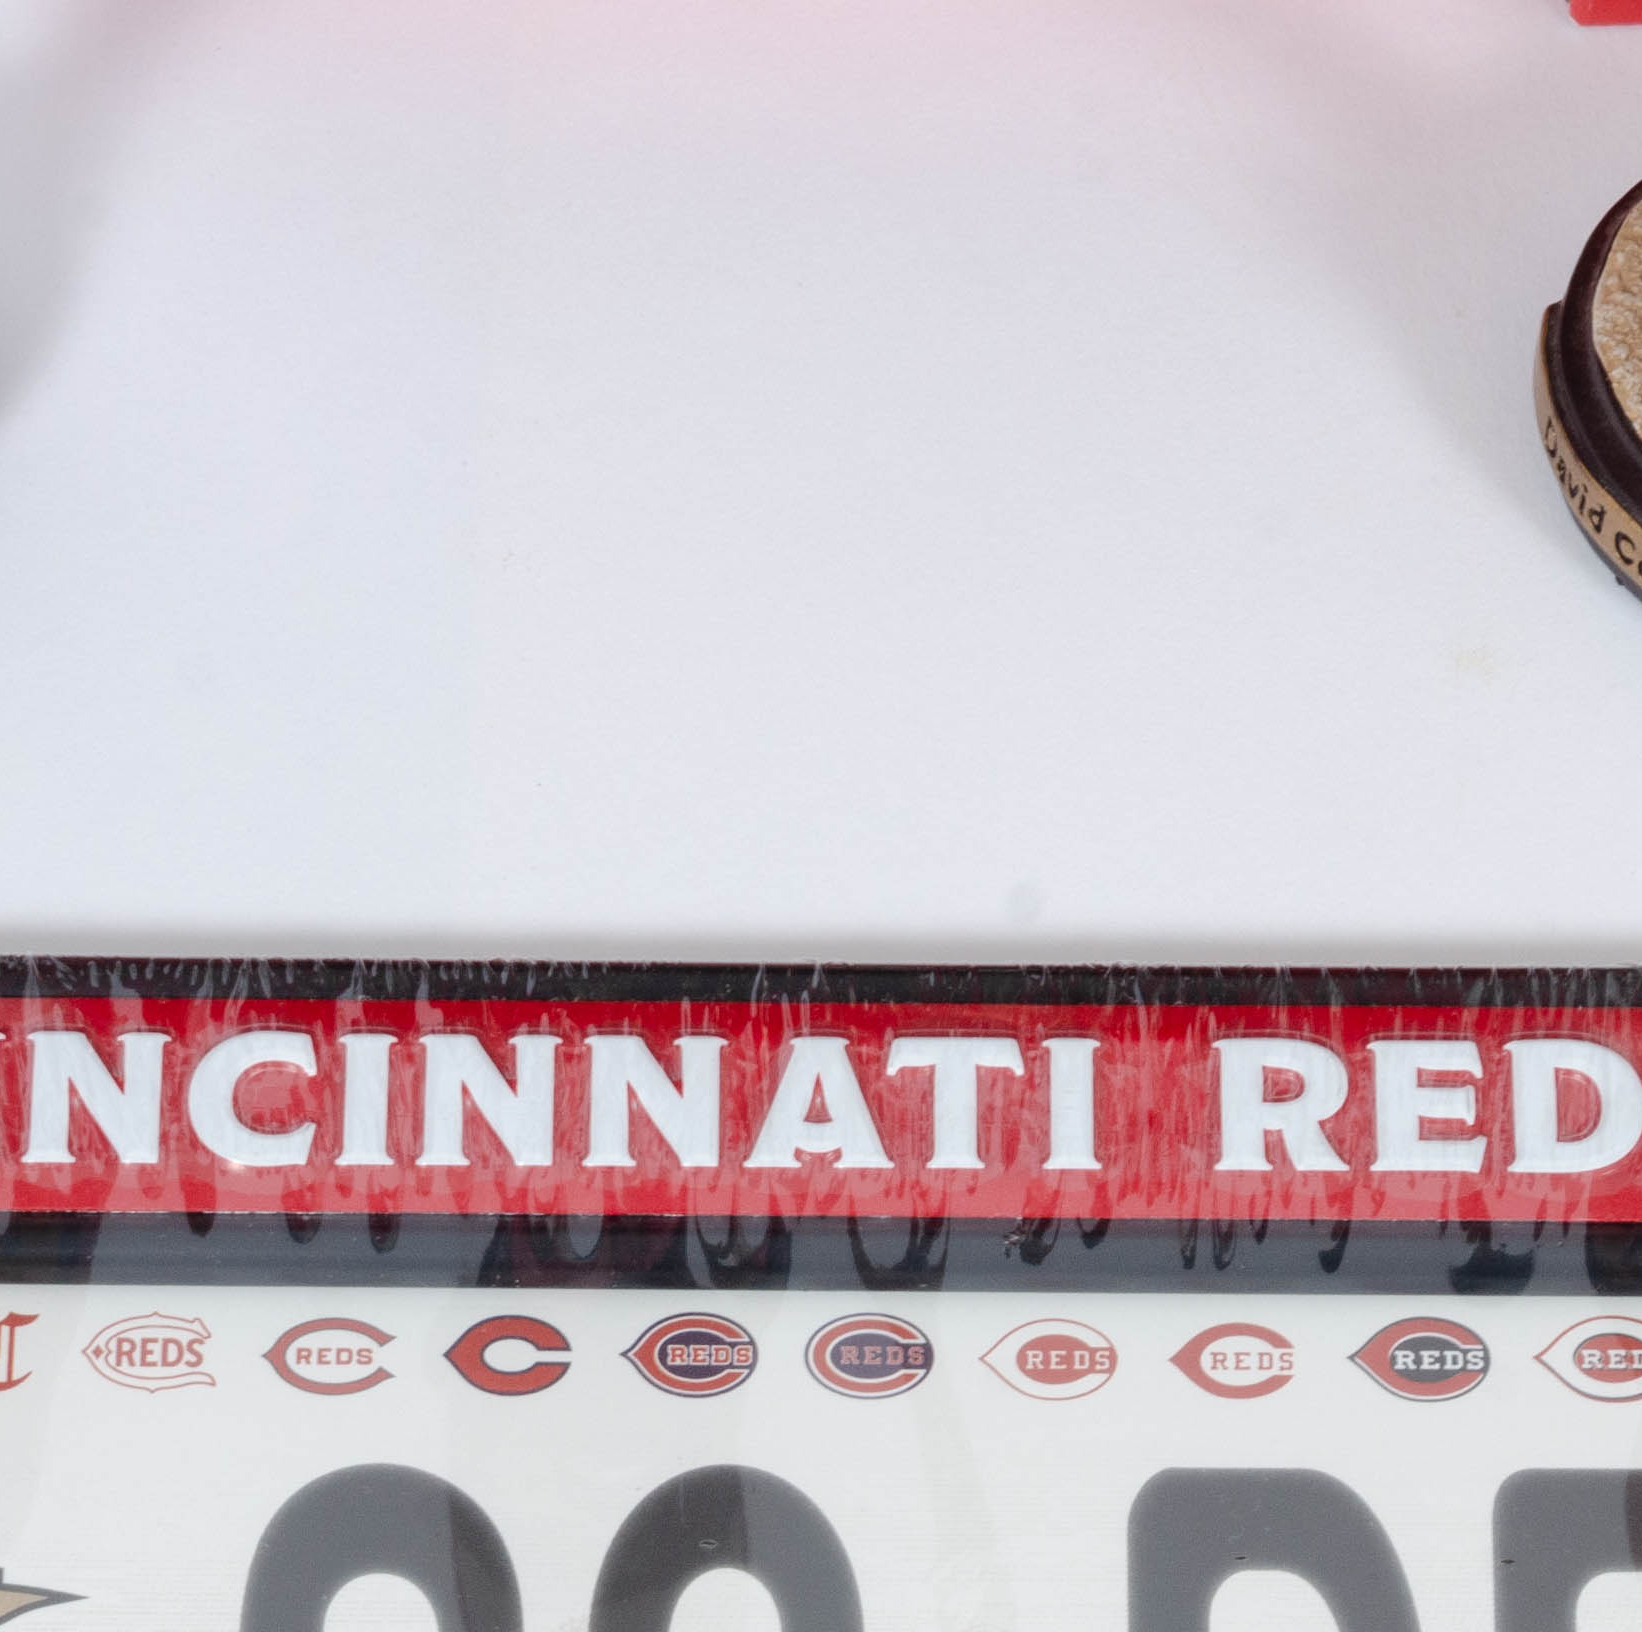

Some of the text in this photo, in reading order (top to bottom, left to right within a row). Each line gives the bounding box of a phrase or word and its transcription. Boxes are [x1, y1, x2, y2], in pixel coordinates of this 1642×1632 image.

[114, 1337, 206, 1368] REDS
[295, 1347, 375, 1366] REDS
[666, 1344, 754, 1366] REDS
[839, 1345, 926, 1366] REDS
[1025, 1350, 1111, 1371] REDS
[1209, 1351, 1295, 1371] REDS
[1392, 1350, 1486, 1371] REDS
